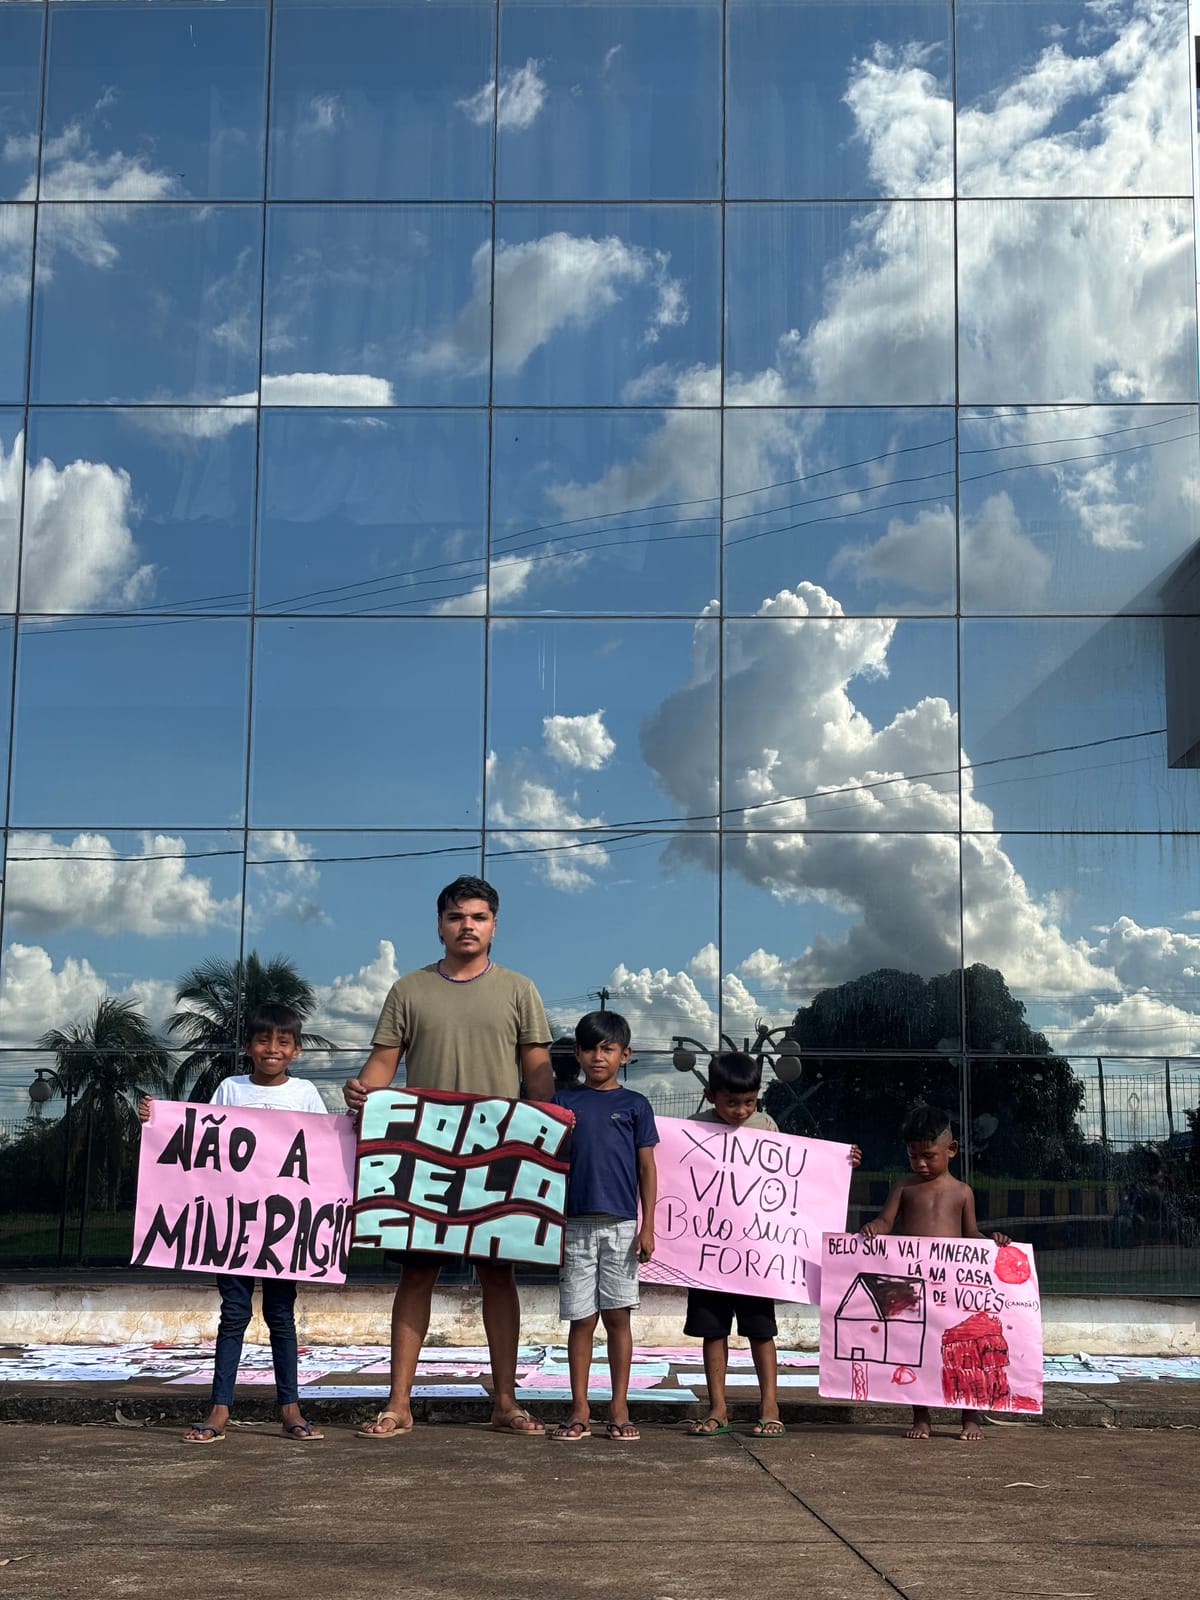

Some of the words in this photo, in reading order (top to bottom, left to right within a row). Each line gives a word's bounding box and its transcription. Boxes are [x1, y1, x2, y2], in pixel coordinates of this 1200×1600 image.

[157, 1107, 257, 1173] NÃO
[276, 1128, 311, 1185] A
[360, 1090, 568, 1156] FORA
[679, 1129, 807, 1178] XINGU
[357, 1153, 567, 1216] BELO
[690, 1166, 798, 1216] VIVO!
[352, 1208, 563, 1266] SUN
[653, 1196, 733, 1241] Belo
[698, 1244, 807, 1287] FORA!!
[828, 1237, 858, 1255] BELO
[862, 1238, 889, 1260] SUN,
[929, 1242, 990, 1265] MINERAR
[907, 1260, 923, 1277] LÁ
[929, 1266, 946, 1282] NA
[956, 1267, 993, 1286] CASA
[933, 1290, 947, 1303] DE
[954, 1287, 1005, 1313] VOCÊS
